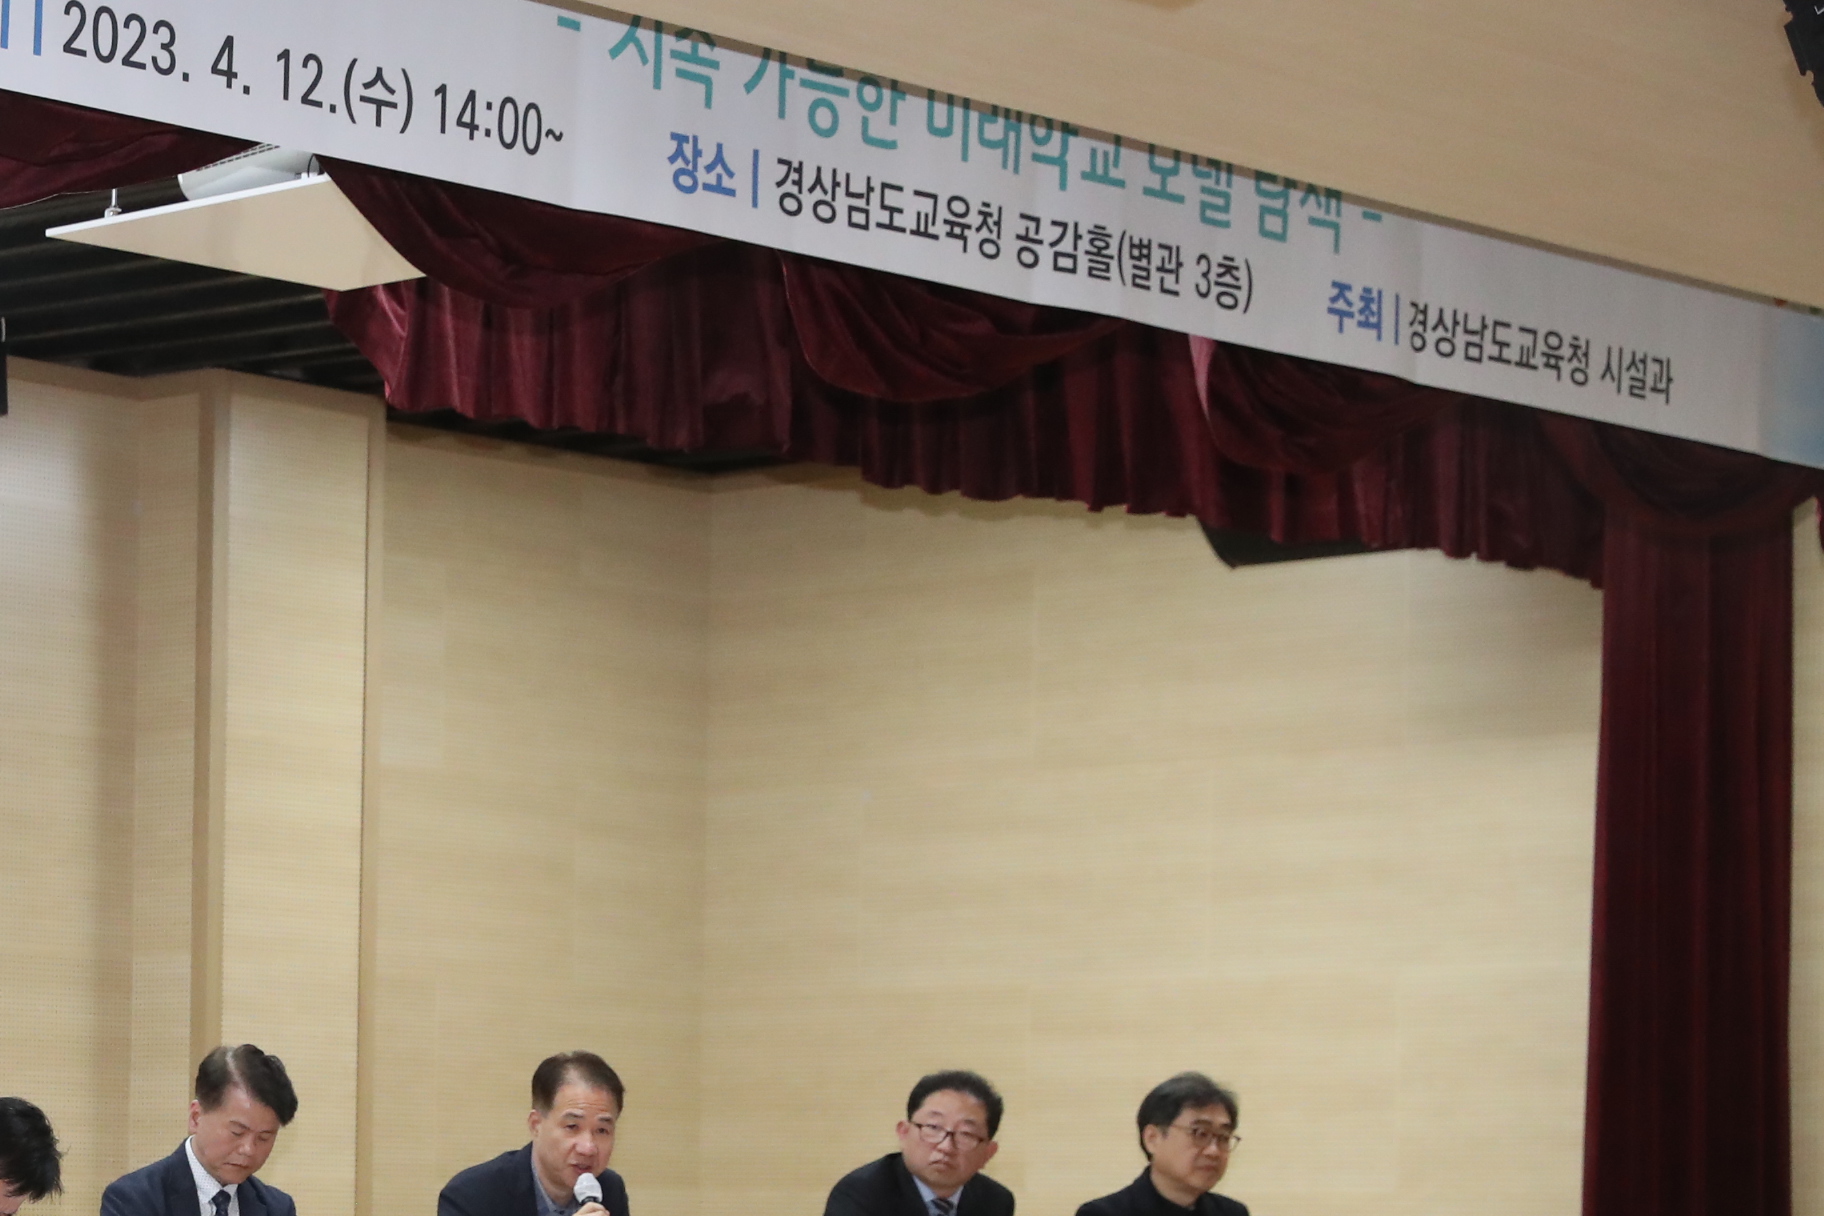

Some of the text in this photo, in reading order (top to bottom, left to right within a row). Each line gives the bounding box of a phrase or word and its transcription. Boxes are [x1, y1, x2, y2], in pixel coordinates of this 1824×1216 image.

[62, 0, 190, 82] 2023.
[211, 35, 252, 95] 4.
[276, 49, 414, 134] 12.(수)
[434, 84, 564, 156] 14:00~
[744, 47, 906, 150] 가능한
[927, 88, 1126, 190] 미래학교
[1143, 143, 1234, 229] 모델
[1255, 170, 1342, 255] 탐색
[667, 131, 1254, 314] 장소 경상남도교육청 공감홀(별관 3층)
[1327, 280, 1674, 404] 주최 경상남도교육청 시설과
